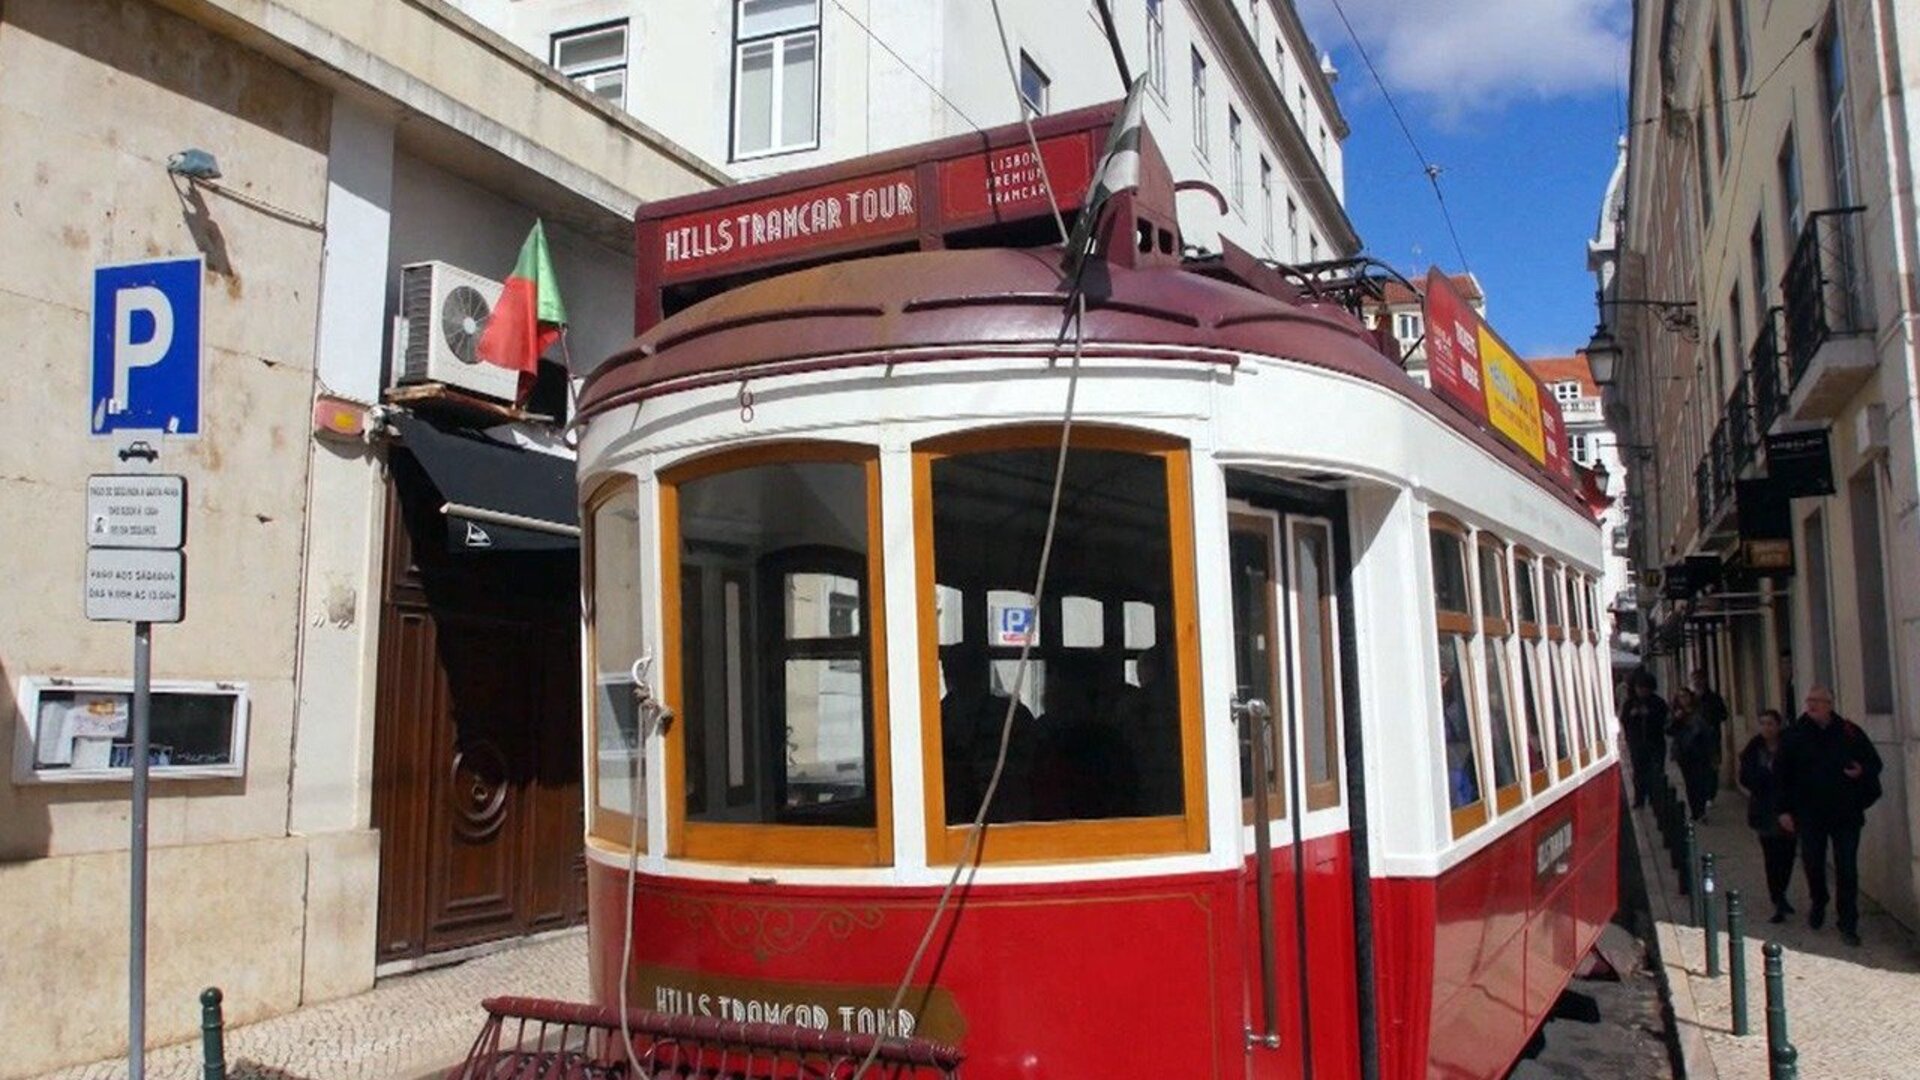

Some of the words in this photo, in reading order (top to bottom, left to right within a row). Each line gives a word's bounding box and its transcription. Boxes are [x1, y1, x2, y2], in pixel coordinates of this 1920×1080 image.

[990, 152, 1039, 173] LISBON
[665, 219, 734, 262] HILLS
[737, 197, 843, 248] TRAMCAR
[846, 183, 914, 225] TOUR
[112, 285, 174, 411] P
[740, 391, 754, 423] 8
[1007, 609, 1024, 633] P
[656, 986, 711, 1017] HILLS
